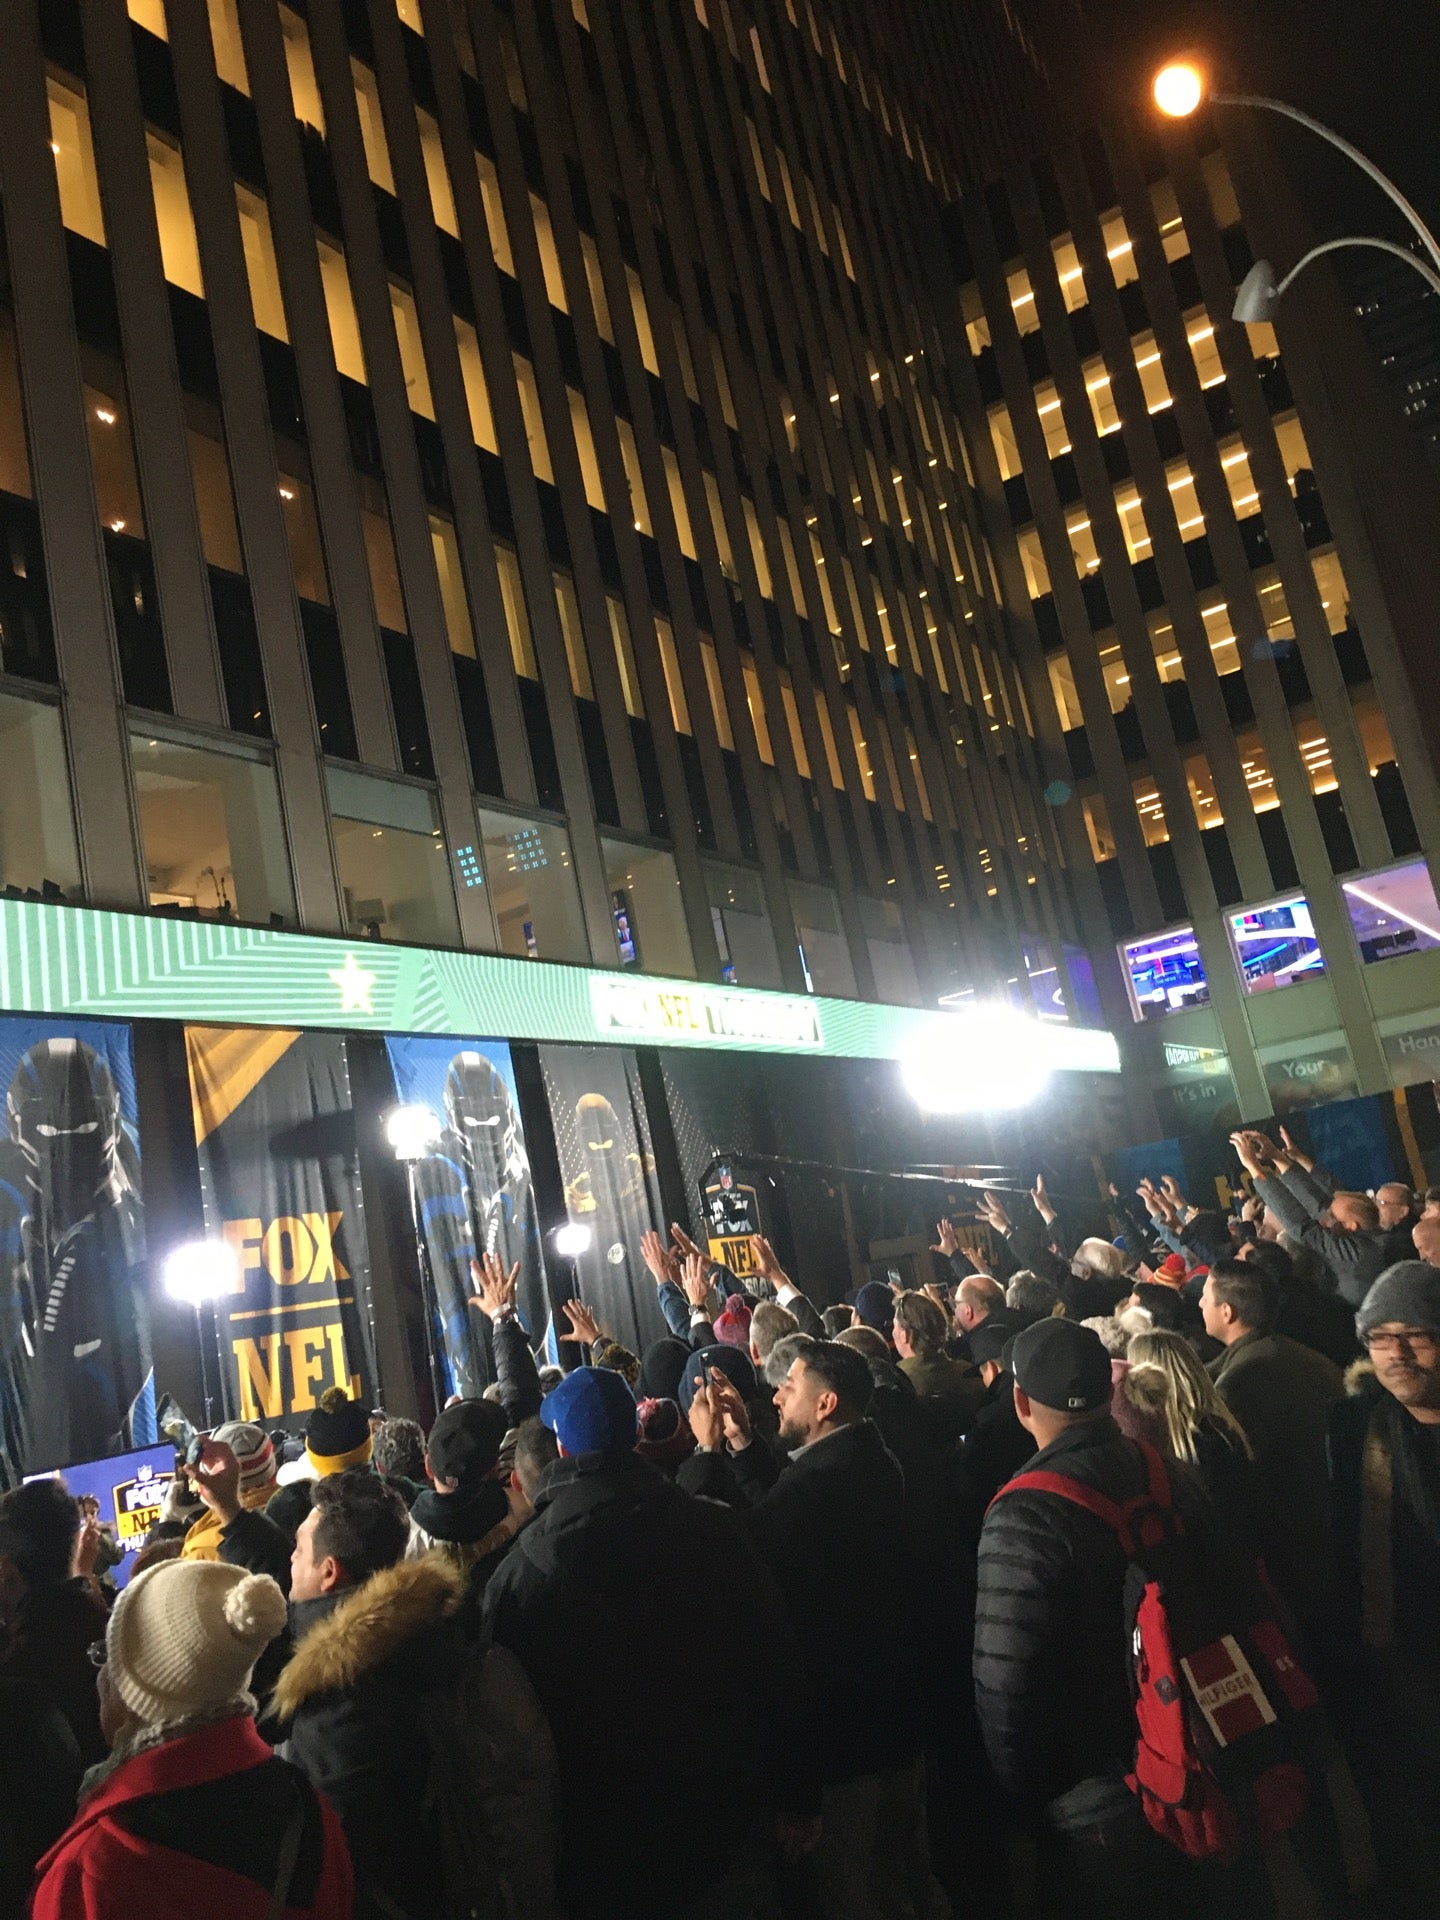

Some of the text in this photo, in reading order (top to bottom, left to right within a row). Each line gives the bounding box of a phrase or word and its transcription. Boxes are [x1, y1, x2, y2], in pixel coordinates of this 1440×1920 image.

[1200, 1083, 1217, 1098] in
[1281, 1060, 1325, 1079] Your
[222, 1211, 351, 1296] FOX
[721, 1239, 758, 1274] NFL
[232, 1322, 363, 1422] NFL
[131, 1508, 160, 1533] NF
[1198, 1672, 1255, 1708] HILFIGER
